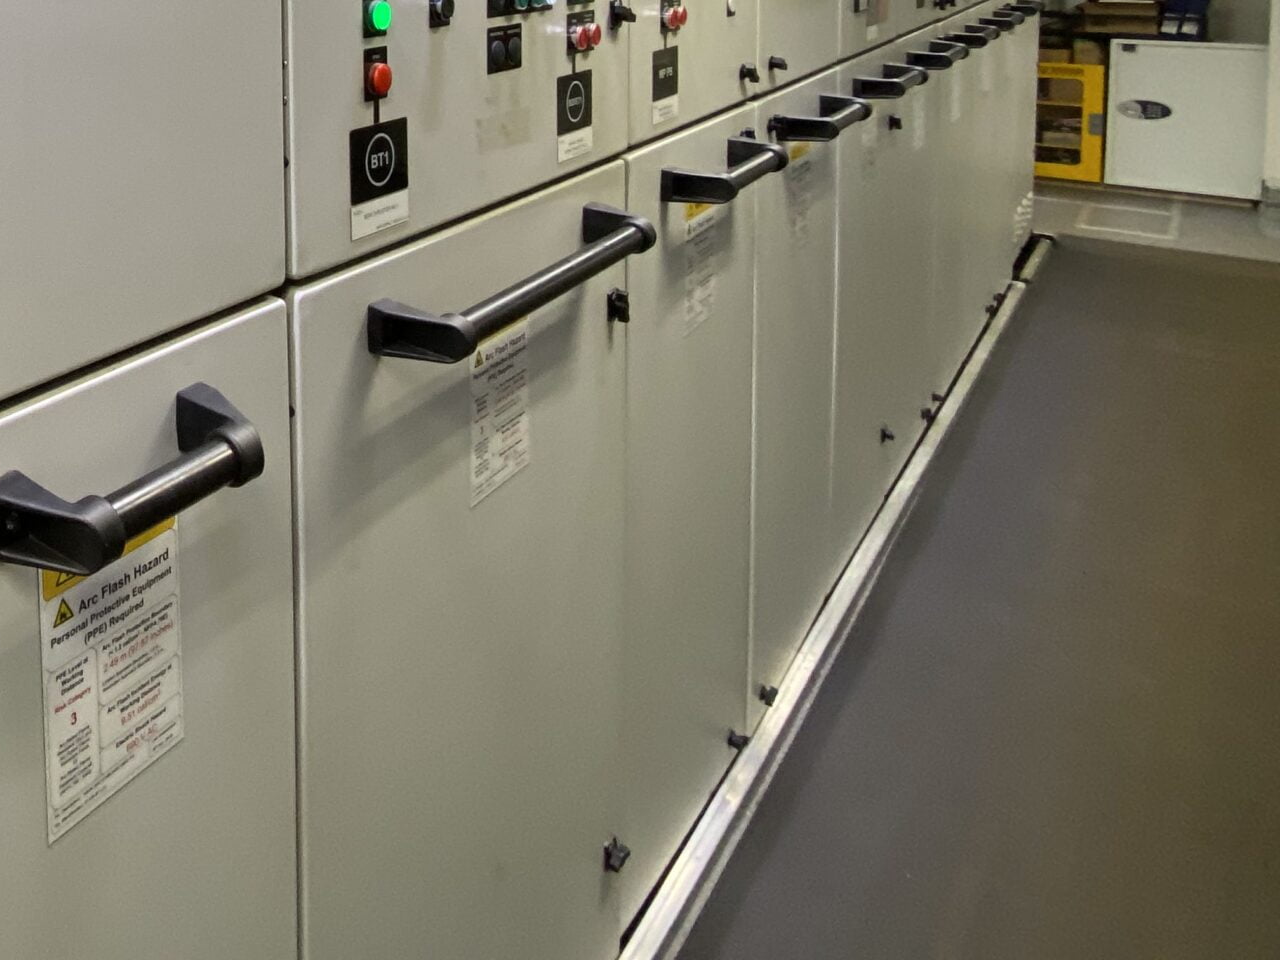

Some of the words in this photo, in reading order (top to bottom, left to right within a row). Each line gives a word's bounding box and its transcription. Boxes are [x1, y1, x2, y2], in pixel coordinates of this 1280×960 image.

[371, 150, 390, 170] BT1
[79, 593, 99, 614] Arc
[101, 572, 132, 600] Flash
[133, 547, 169, 580] Hazard
[50, 618, 89, 649] Personal
[90, 593, 131, 625] Protective
[132, 566, 172, 598] Equipment
[84, 621, 108, 646] (PPE)
[109, 598, 145, 628] Required
[70, 711, 78, 726] 3
